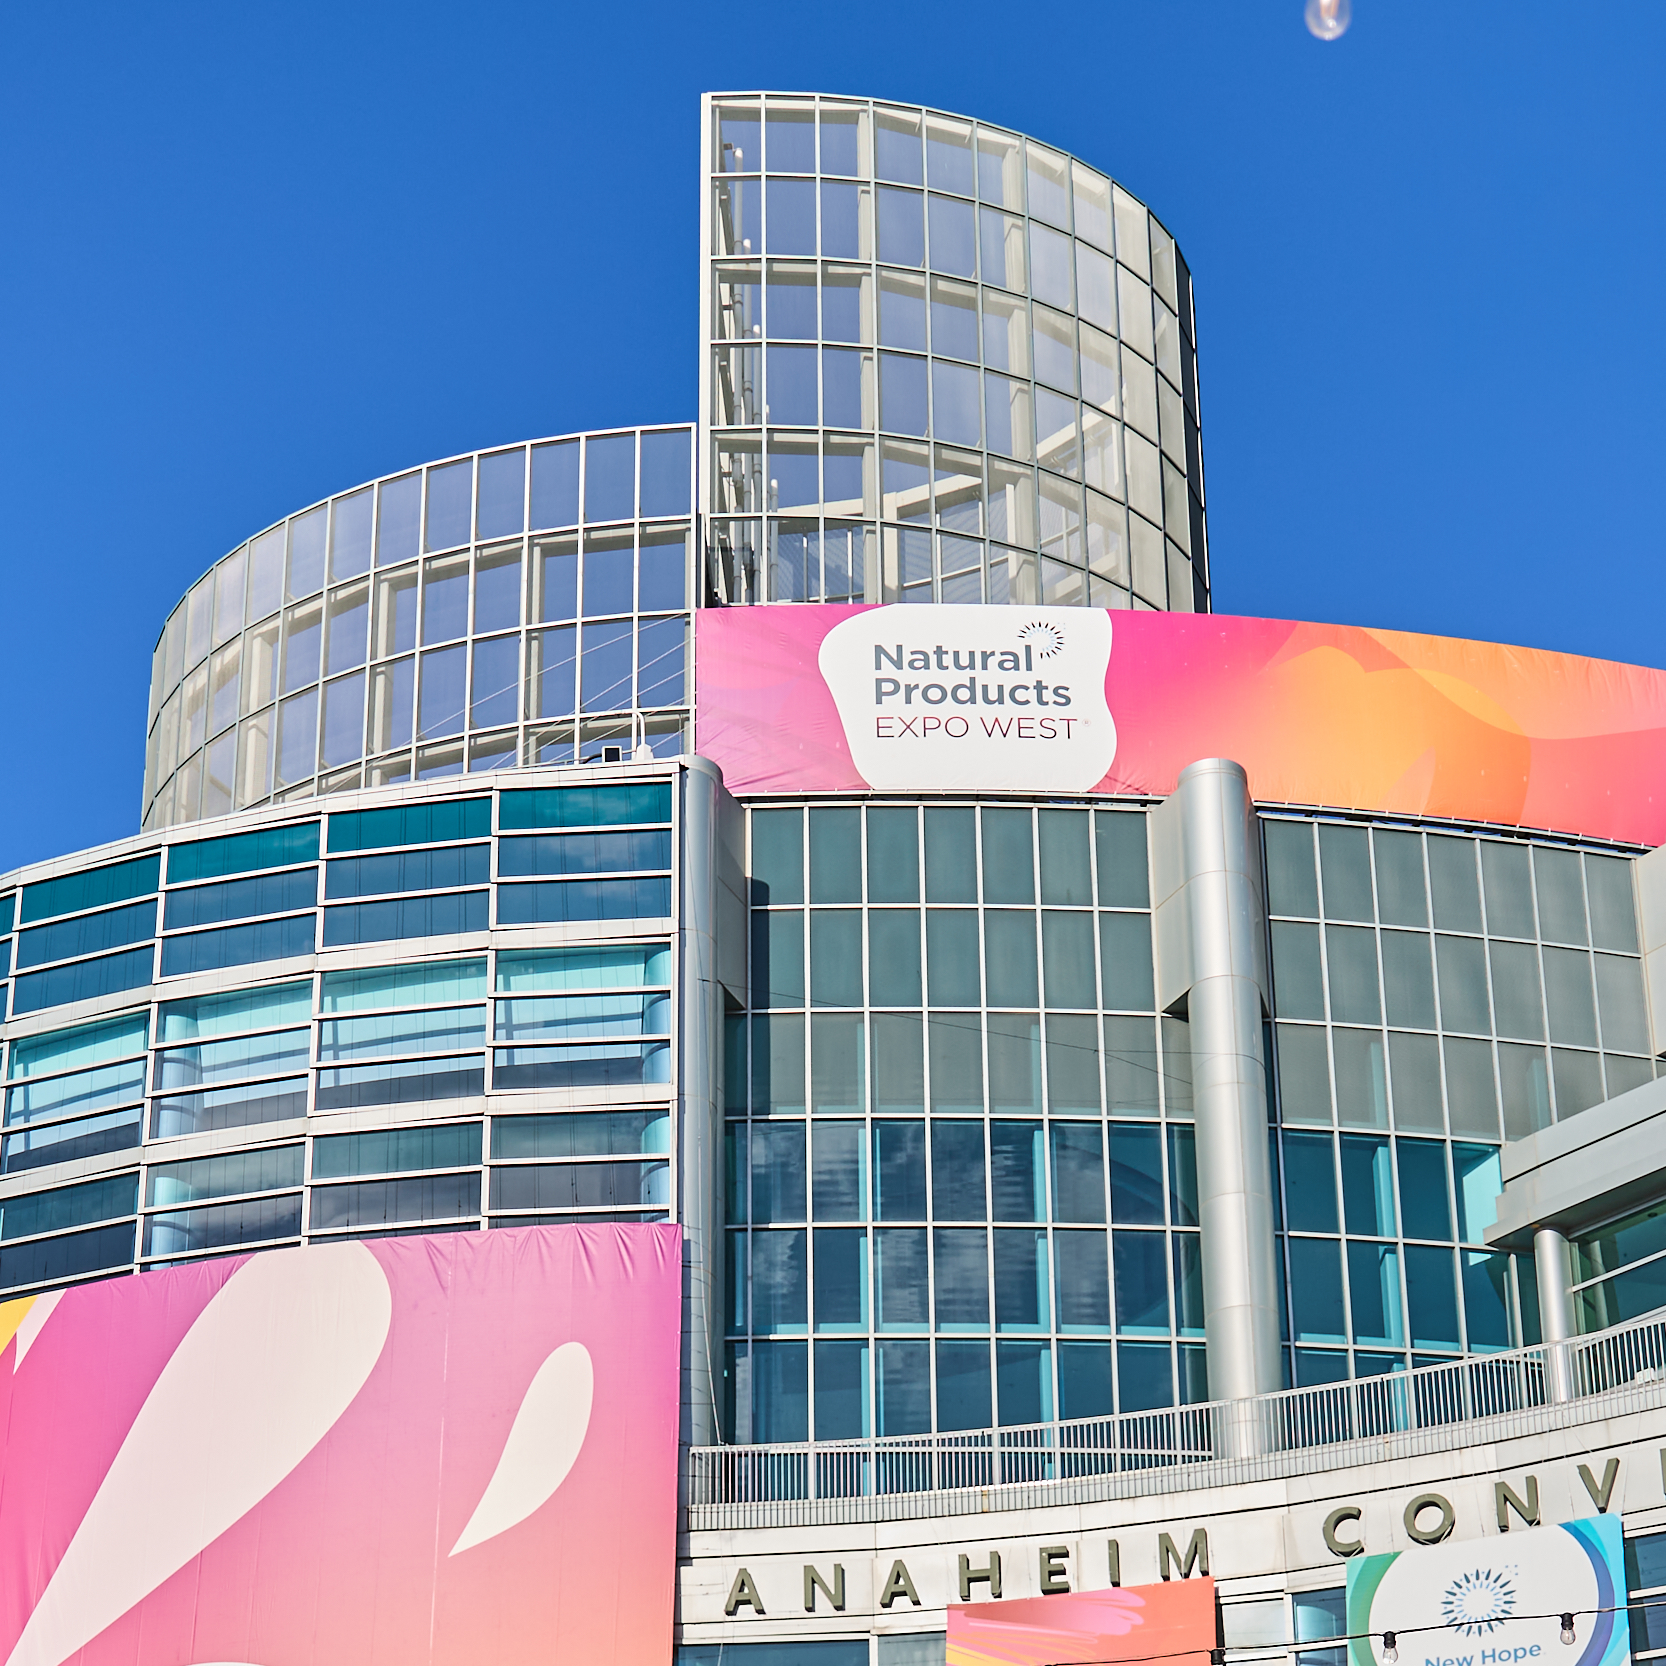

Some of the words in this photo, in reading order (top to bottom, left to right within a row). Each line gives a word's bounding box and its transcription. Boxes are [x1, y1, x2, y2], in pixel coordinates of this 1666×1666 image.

[874, 644, 1033, 671] Natural
[874, 676, 1072, 707] Products
[876, 716, 969, 738] EXPO
[723, 1527, 1210, 1616] ANAHEIM
[1481, 1644, 1541, 1665] Hope
